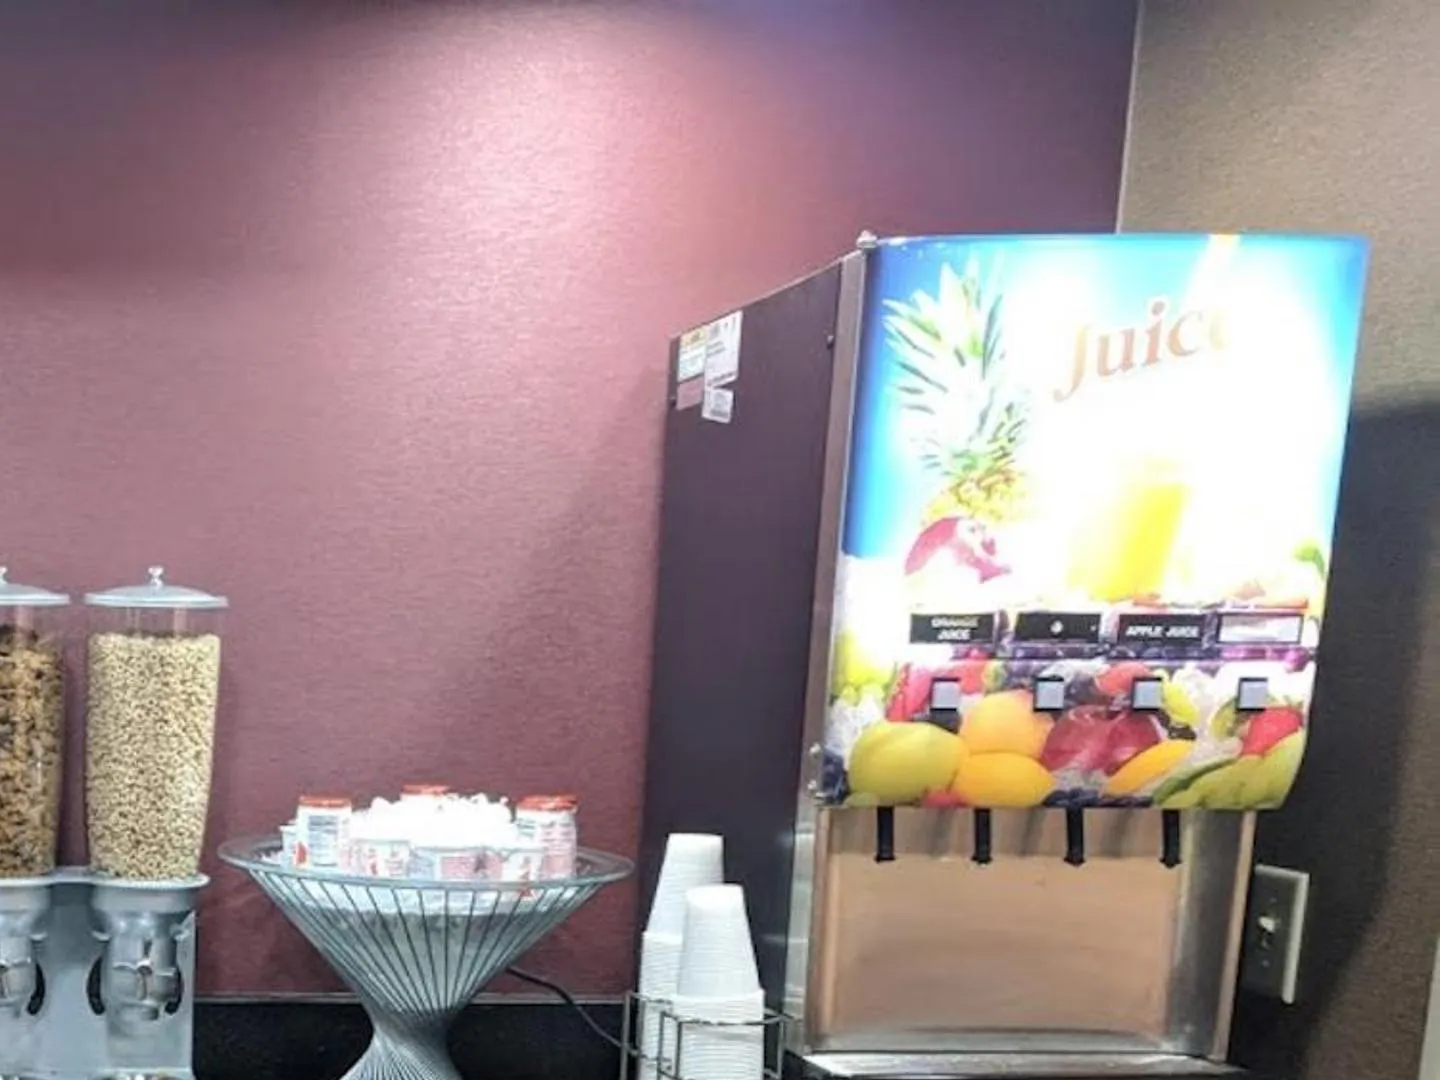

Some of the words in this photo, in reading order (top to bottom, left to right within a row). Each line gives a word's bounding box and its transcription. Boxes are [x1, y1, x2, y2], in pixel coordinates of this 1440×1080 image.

[937, 629, 971, 640] JUICE
[1125, 625, 1163, 637] APPLE
[1166, 625, 1199, 638] JUICE
